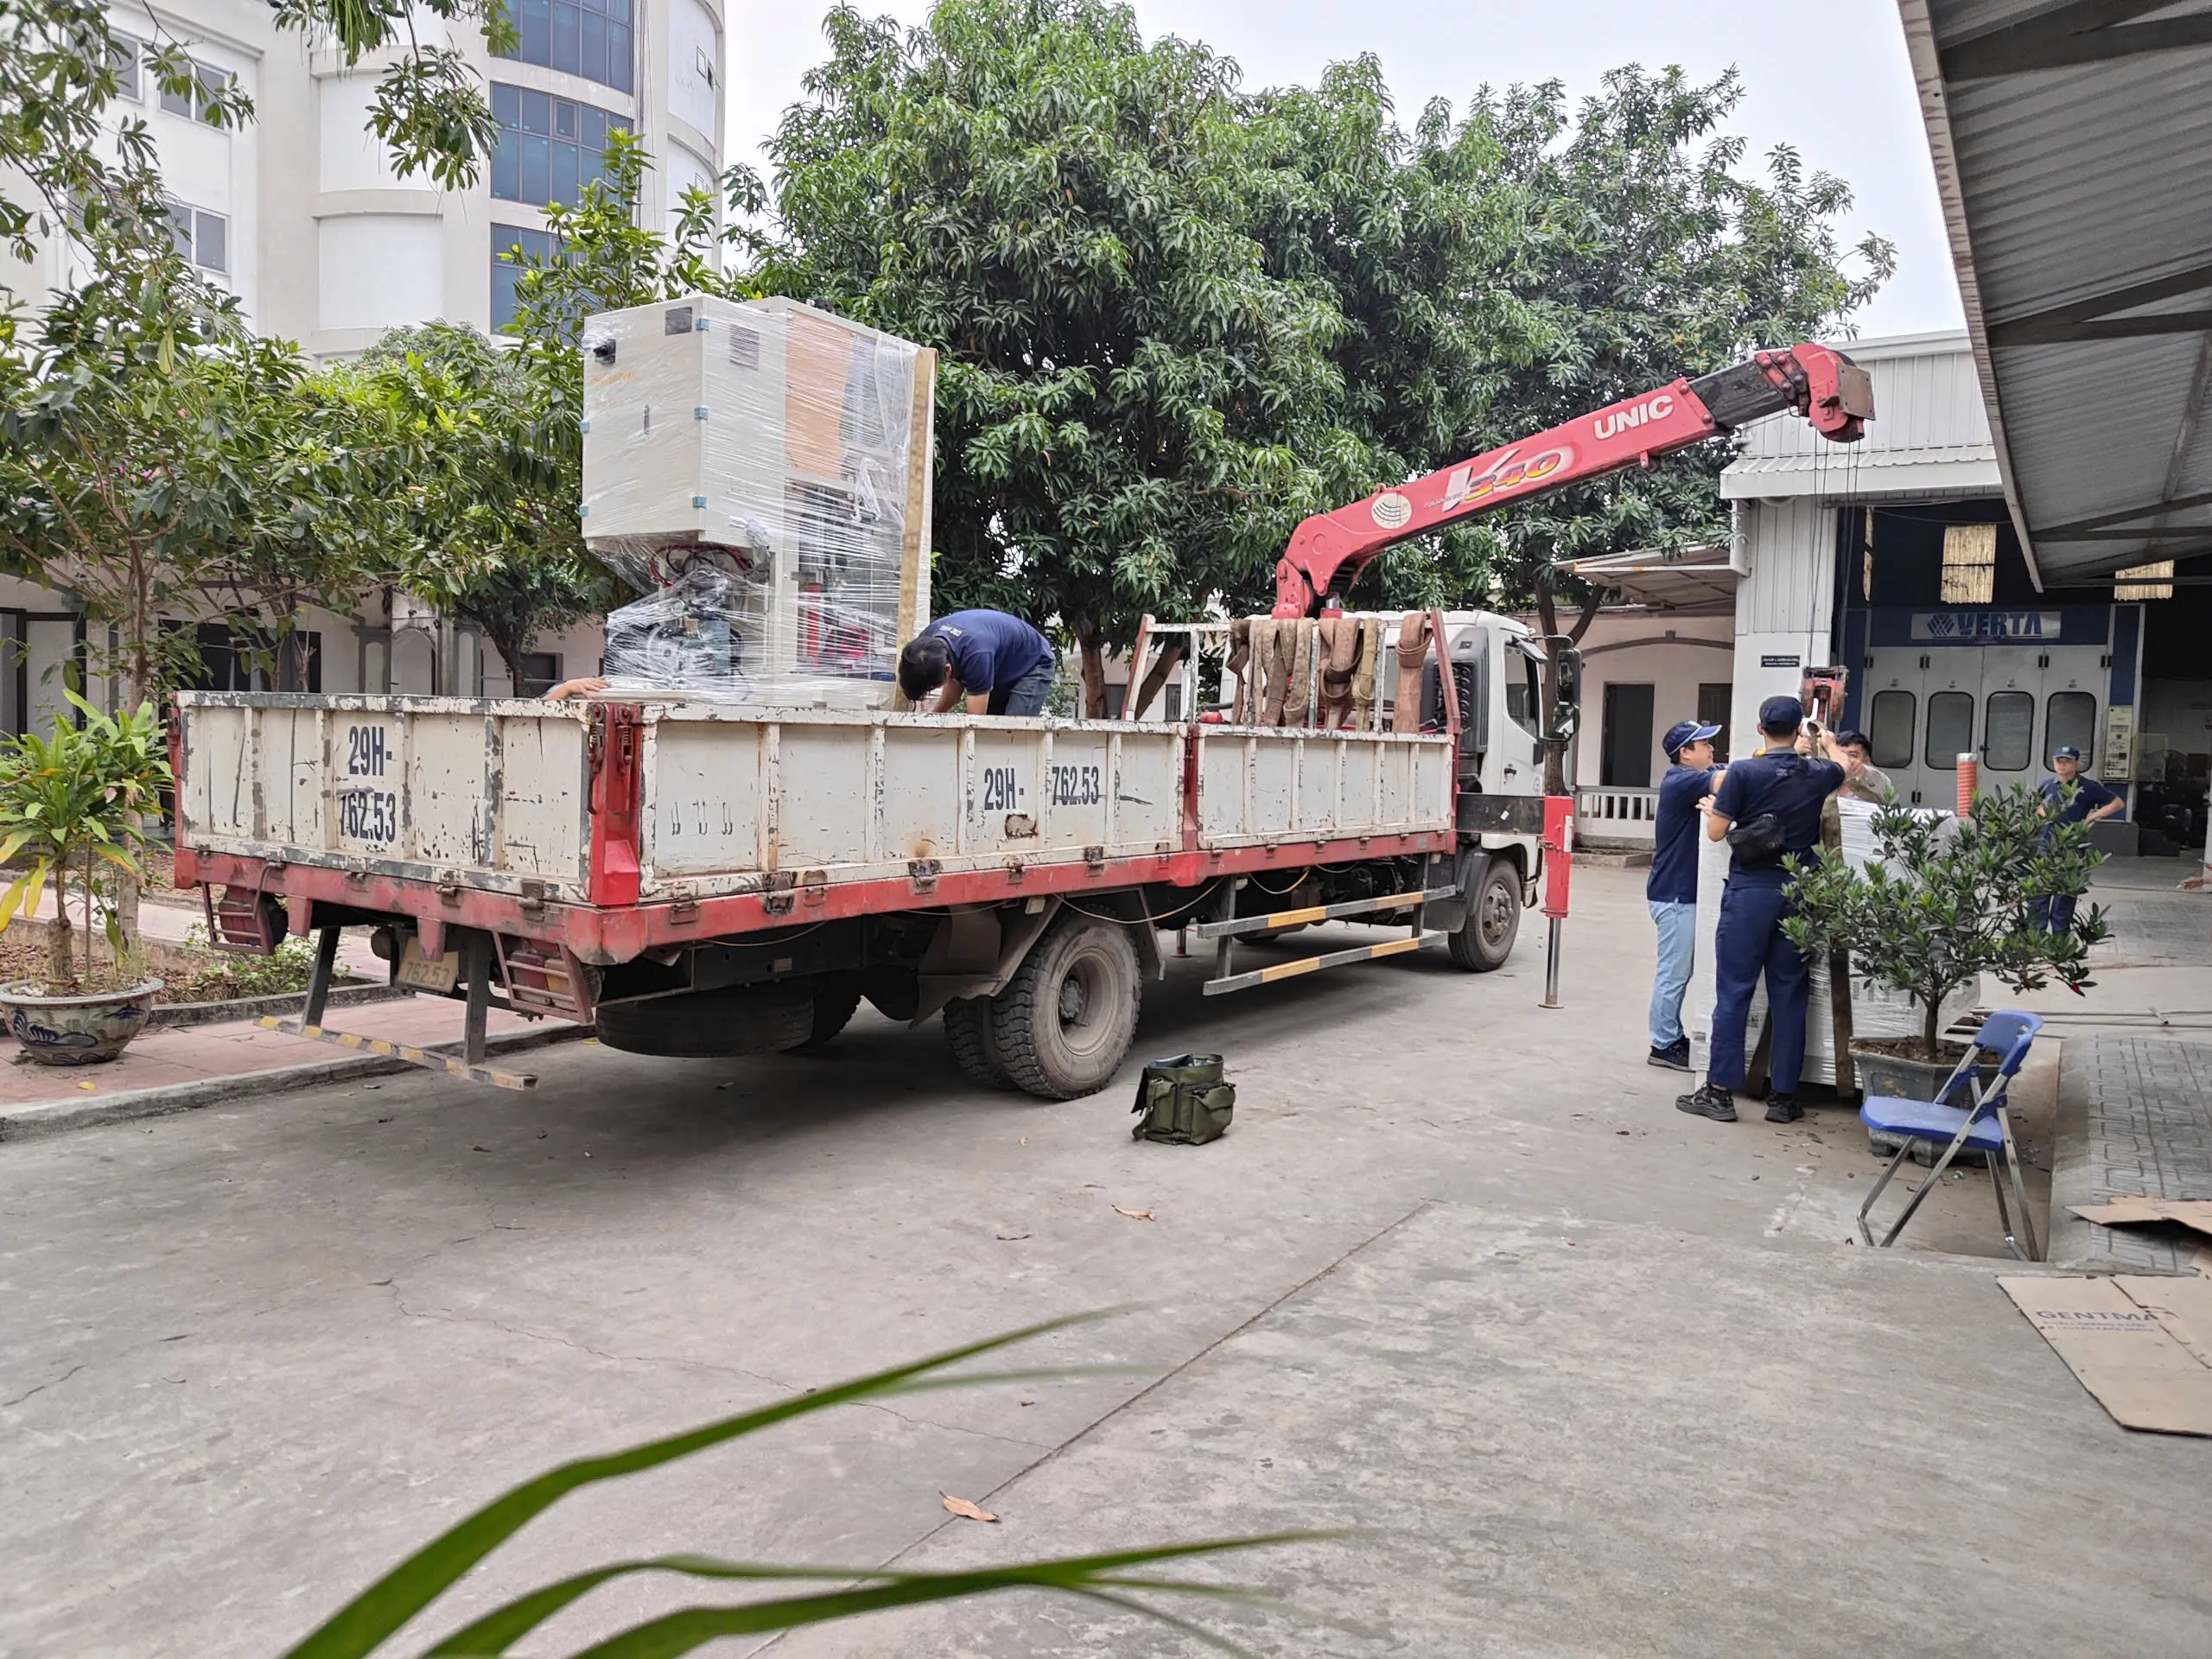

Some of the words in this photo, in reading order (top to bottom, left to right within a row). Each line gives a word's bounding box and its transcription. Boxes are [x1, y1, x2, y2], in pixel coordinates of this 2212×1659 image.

[1594, 395, 1674, 440] UNIC
[1957, 613, 2042, 636] VERTA
[349, 726, 392, 776] 29H-
[1052, 766, 1099, 806] 762.53
